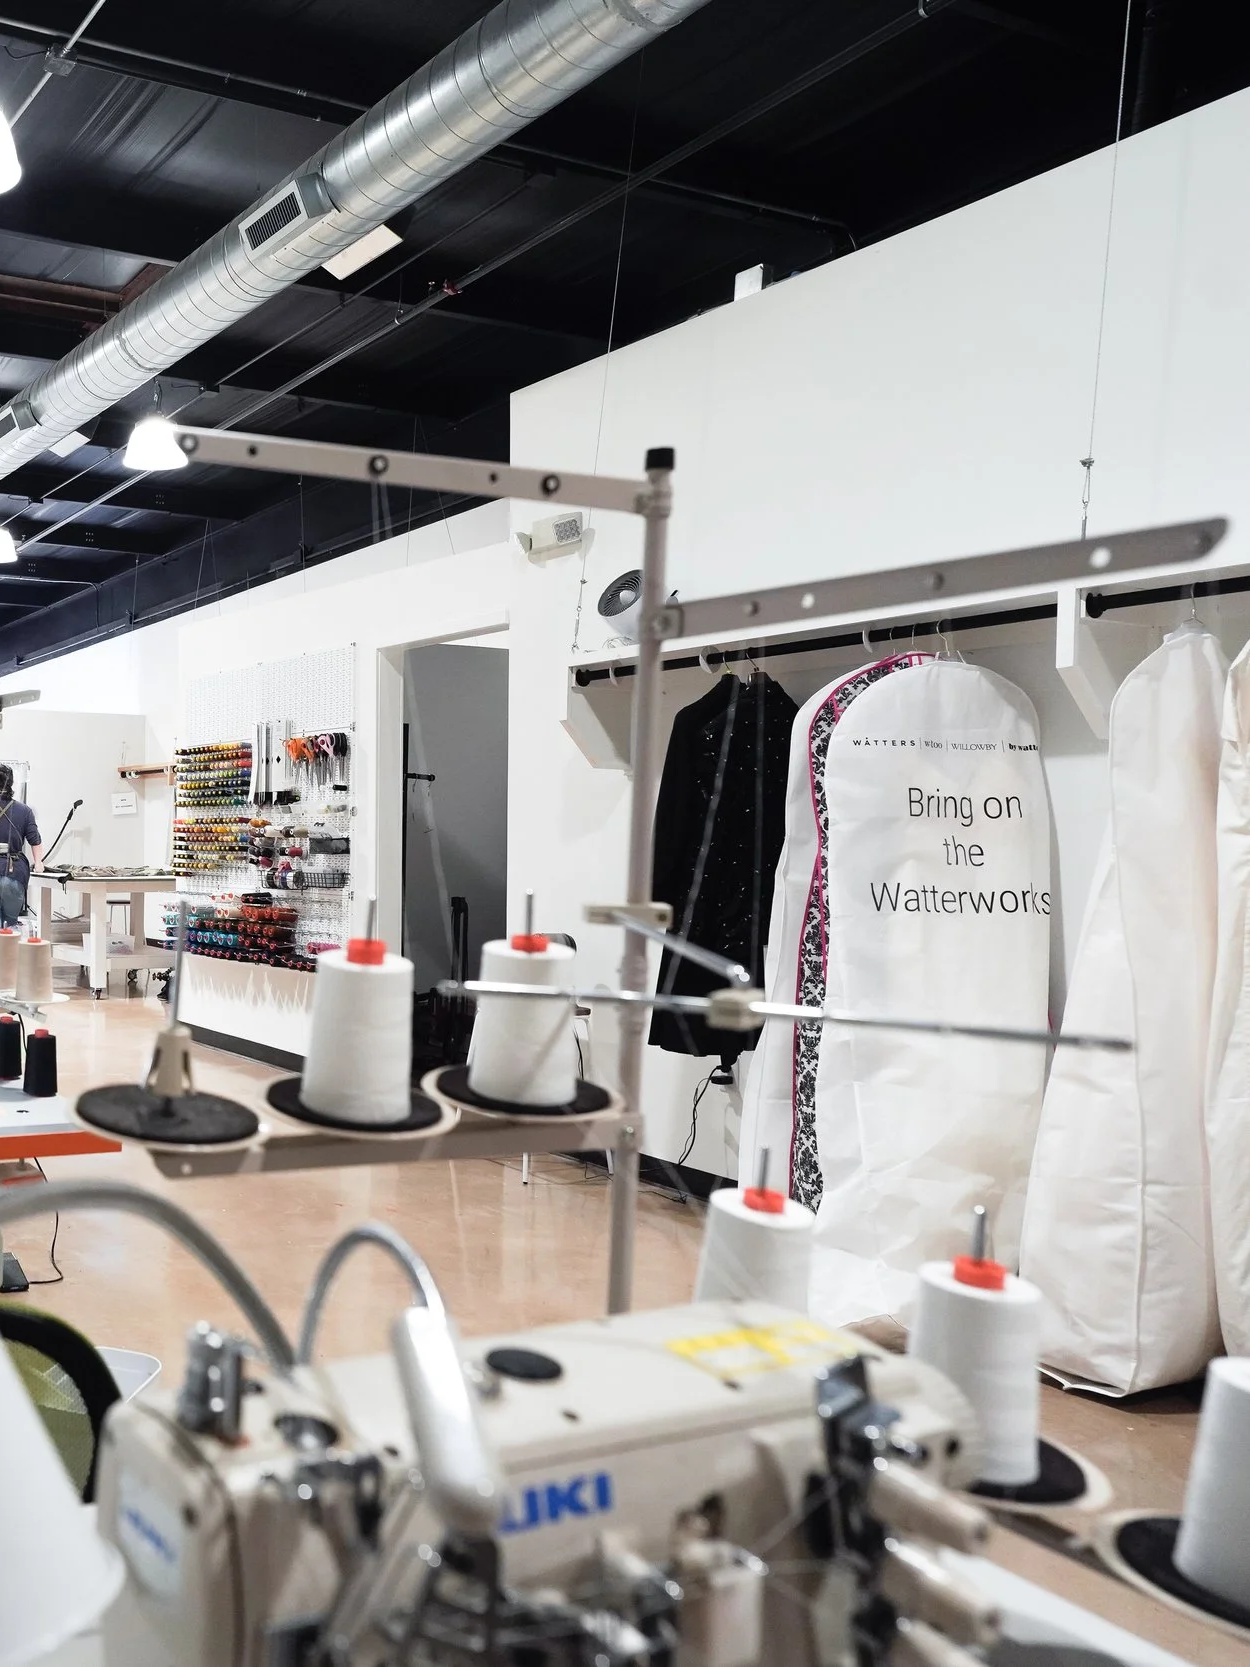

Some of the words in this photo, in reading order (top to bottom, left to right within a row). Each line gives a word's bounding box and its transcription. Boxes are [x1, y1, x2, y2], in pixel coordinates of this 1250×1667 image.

[951, 743, 997, 751] WILLOWBY
[1009, 743, 1017, 752] by
[908, 787, 974, 827] Bring
[983, 796, 1023, 819] on
[943, 835, 984, 867] the
[870, 882, 1050, 915] Watterworks
